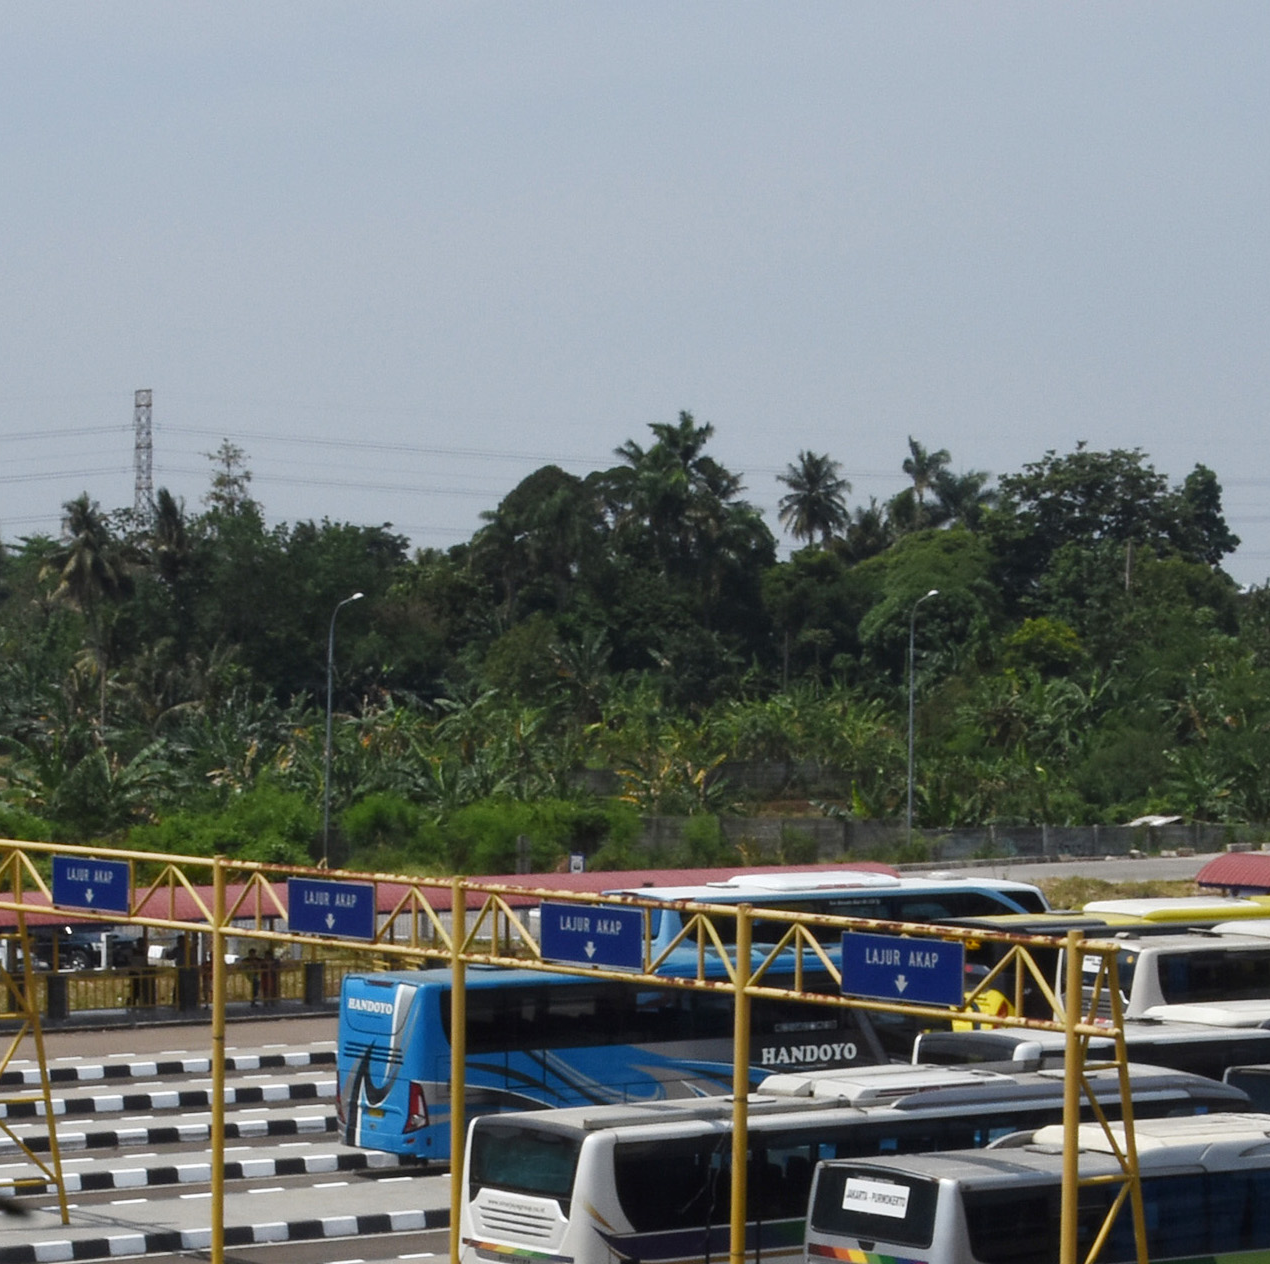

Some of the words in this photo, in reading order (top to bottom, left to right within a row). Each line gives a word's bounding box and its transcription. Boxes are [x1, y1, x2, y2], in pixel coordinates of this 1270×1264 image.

[66, 867, 89, 881] LAJUR
[94, 870, 114, 884] AKAP
[304, 890, 330, 906] LAJUR
[335, 892, 358, 908] AKAP
[559, 915, 590, 932] LAJUR
[596, 919, 623, 935] AKAP
[865, 947, 901, 966] LAJUR
[908, 951, 940, 969] AKAP
[348, 997, 394, 1015] HANDOYO
[761, 1042, 857, 1065] HANDOYO
